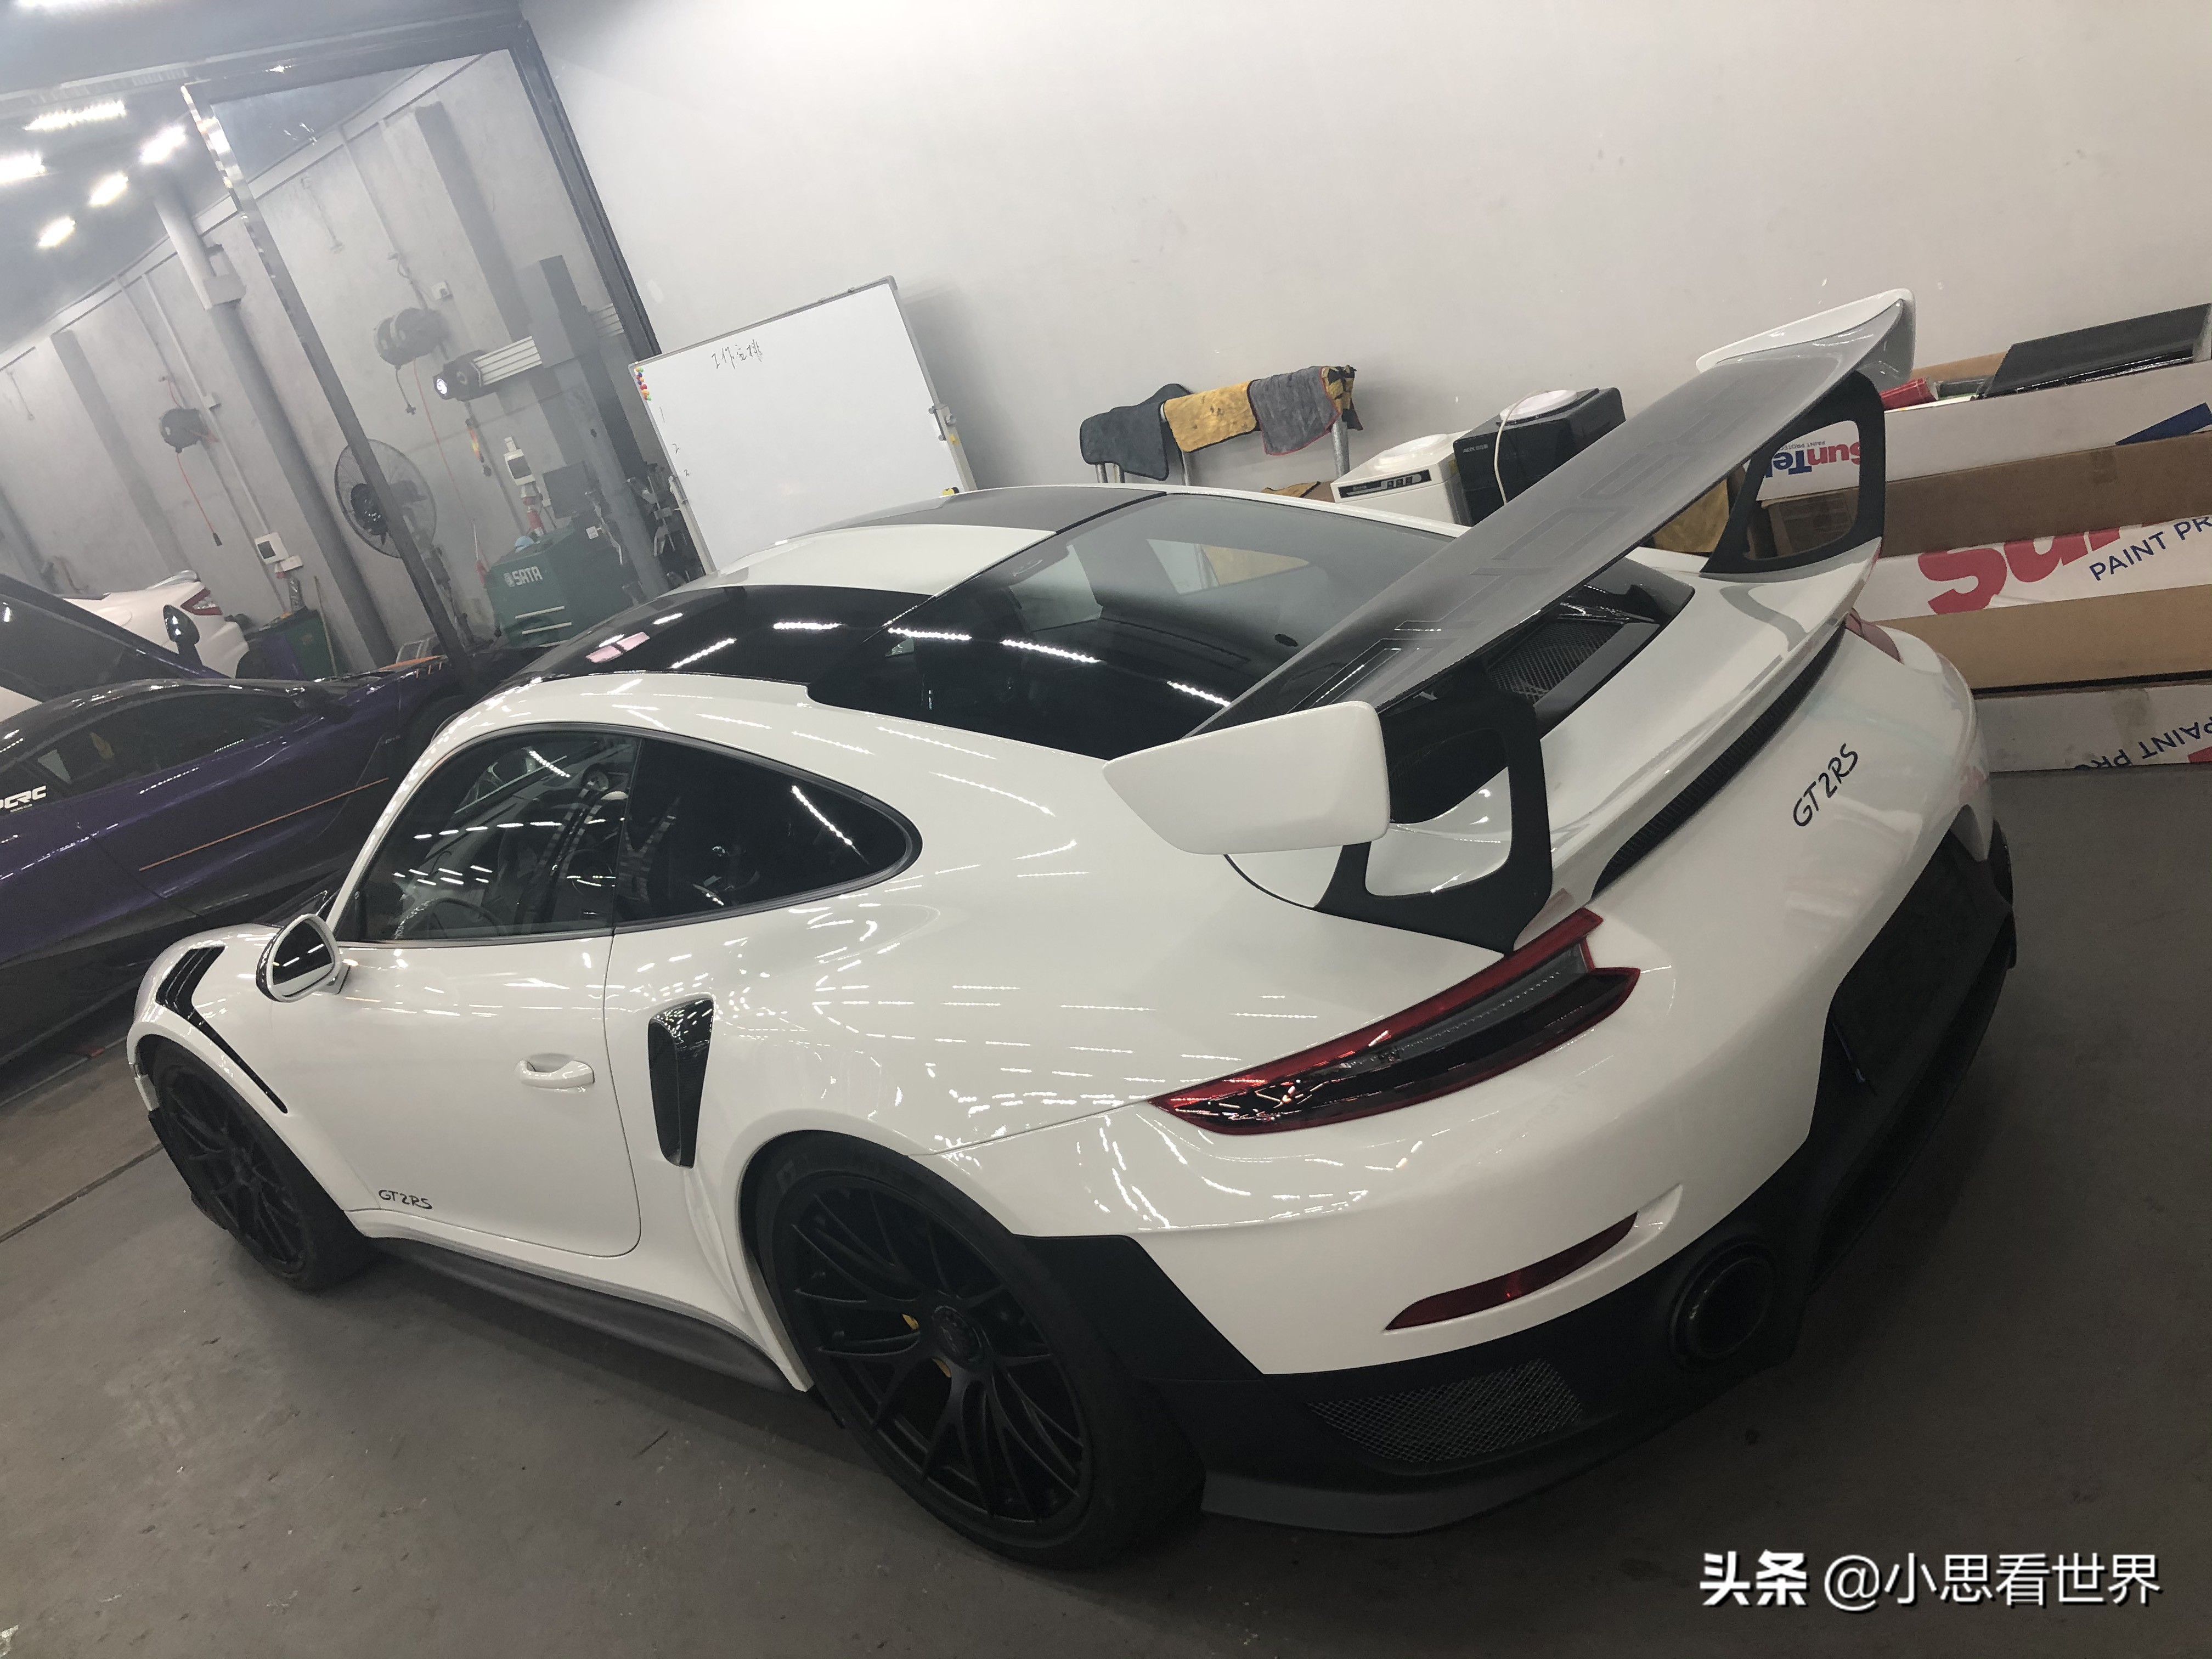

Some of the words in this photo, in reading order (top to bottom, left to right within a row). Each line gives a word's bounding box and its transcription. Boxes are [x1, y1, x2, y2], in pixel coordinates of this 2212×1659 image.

[2089, 531, 2166, 581] PAINT
[511, 566, 543, 586] SATA
[2074, 749, 2132, 770] PR
